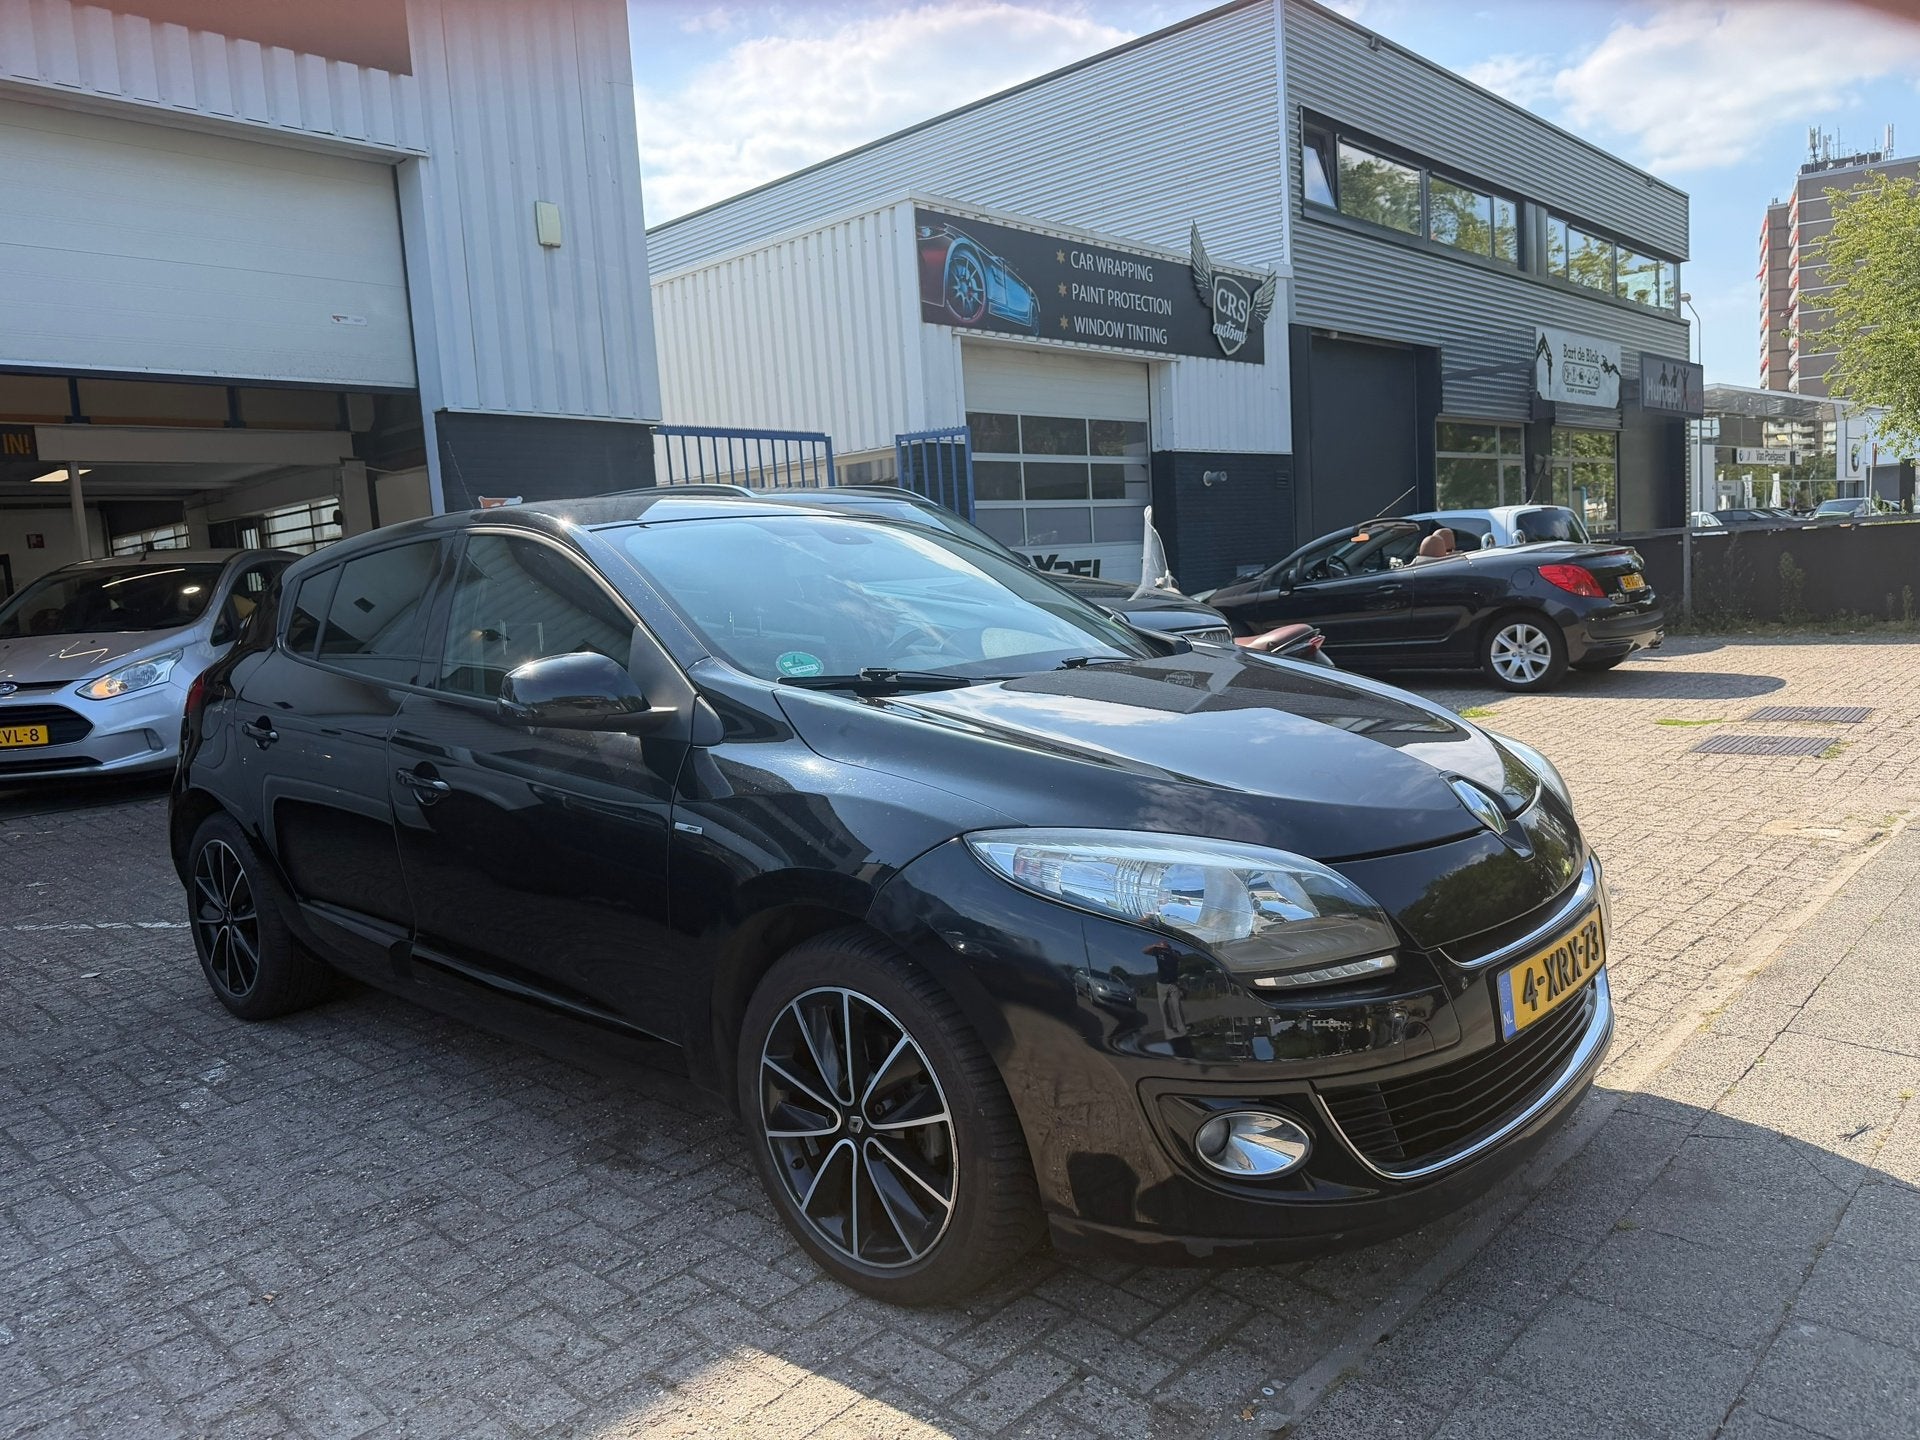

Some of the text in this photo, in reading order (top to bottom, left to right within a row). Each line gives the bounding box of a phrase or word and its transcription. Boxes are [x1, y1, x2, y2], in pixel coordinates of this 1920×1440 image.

[1070, 251, 1153, 282] CAR WRAPPING
[1072, 283, 1172, 316] PAINT PROTECTION
[1216, 288, 1247, 323] CRS
[1073, 316, 1168, 345] WINDOW TINTING
[1212, 321, 1248, 345] customs
[1577, 346, 1585, 361] de
[2, 433, 32, 455] IN!
[0, 728, 39, 744] VL-8
[1522, 921, 1600, 1012] 4-XRX-73
[1503, 1010, 1513, 1026] NL
